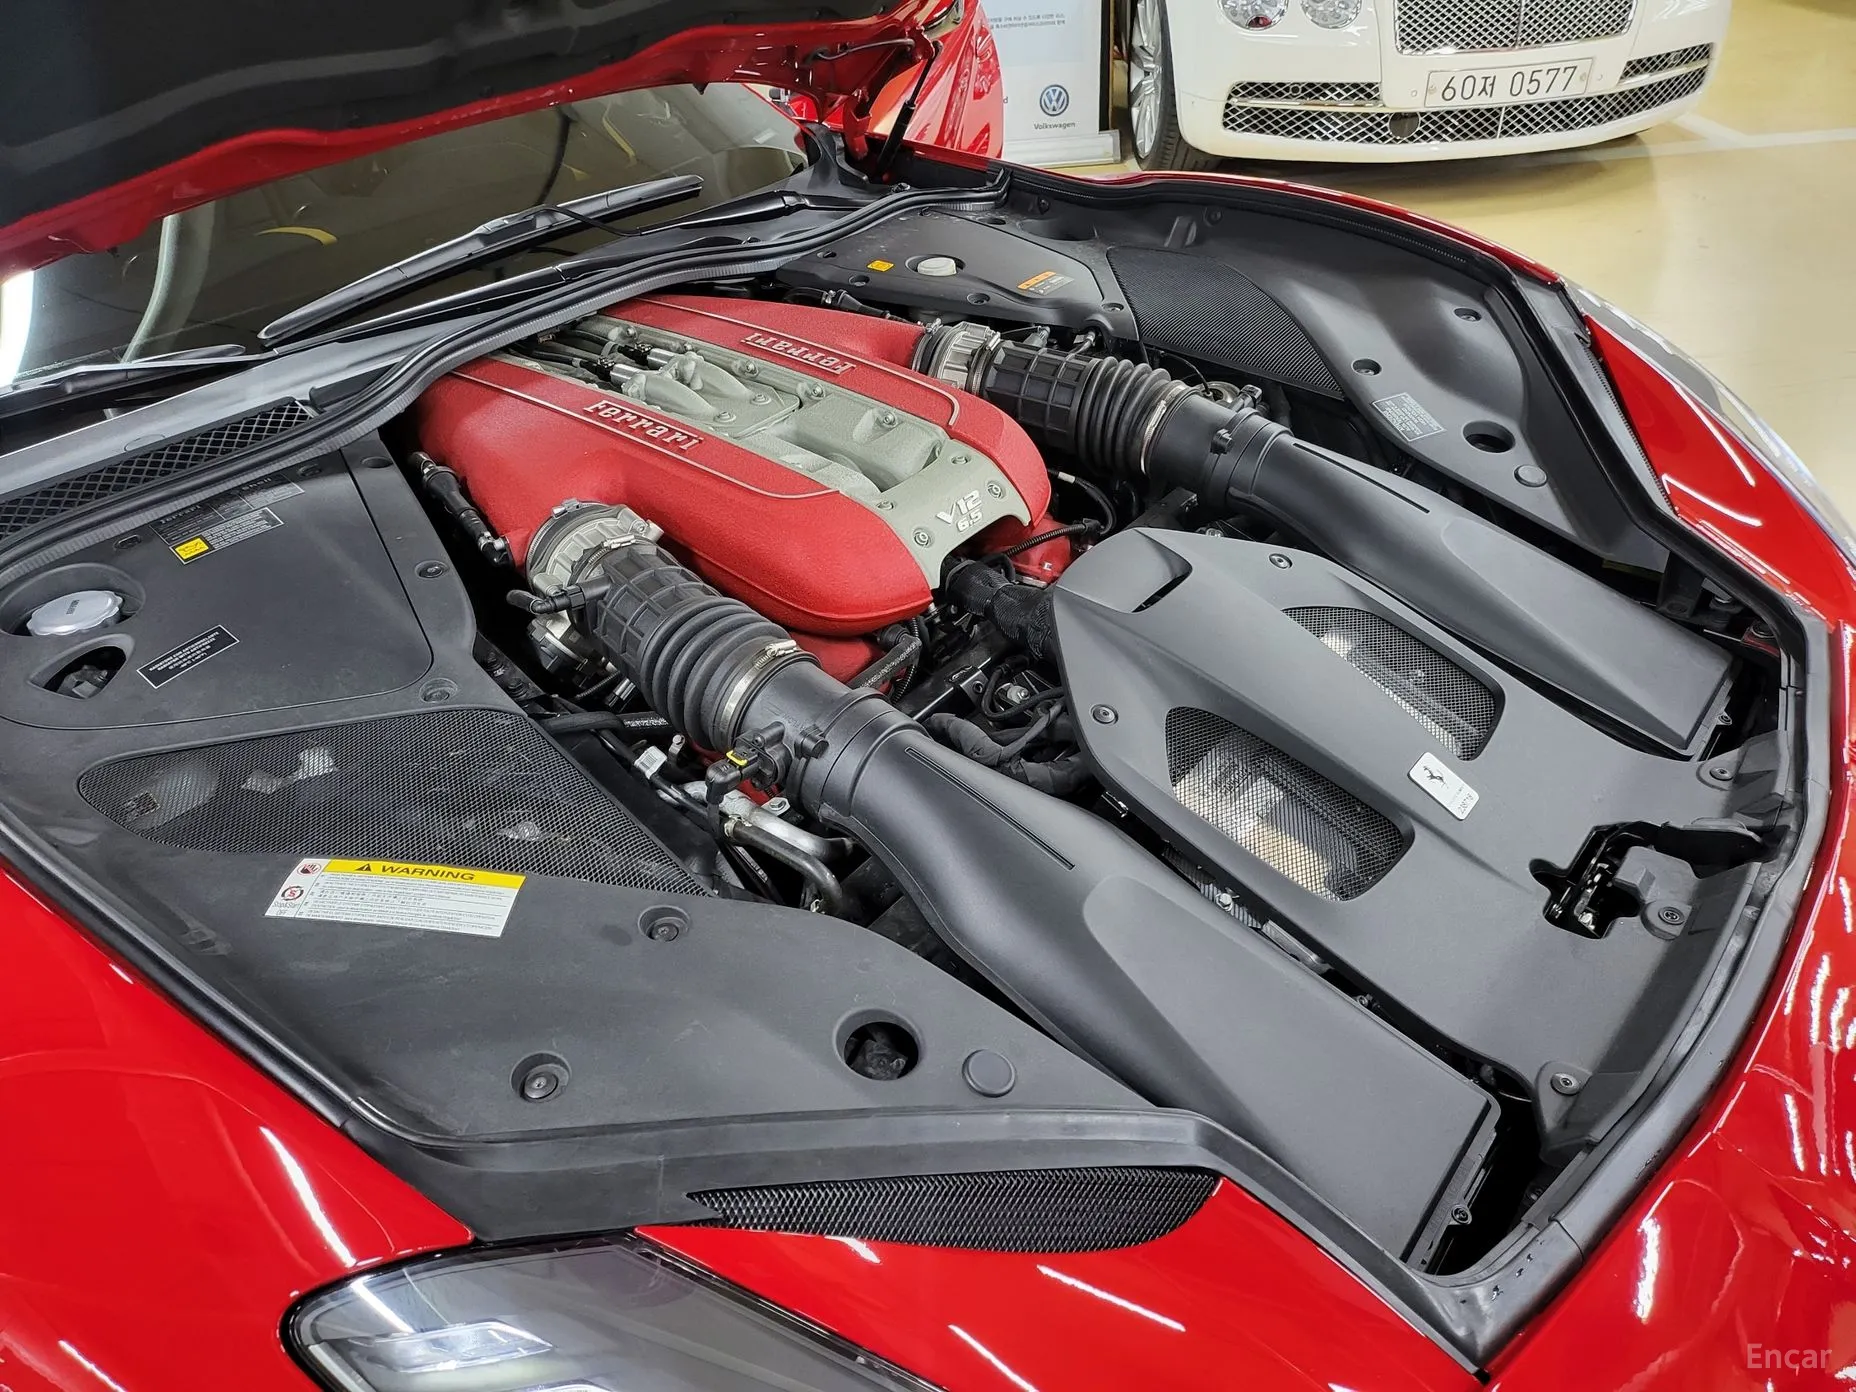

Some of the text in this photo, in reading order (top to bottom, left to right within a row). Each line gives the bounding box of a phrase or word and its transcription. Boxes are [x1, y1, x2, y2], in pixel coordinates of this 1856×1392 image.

[1441, 66, 1578, 101] 60저 0577
[1033, 122, 1076, 130] Volkswagen
[741, 333, 856, 375] Ferrari
[583, 400, 704, 451] Ferrari
[936, 489, 983, 525] V12
[381, 865, 475, 882] WARNING
